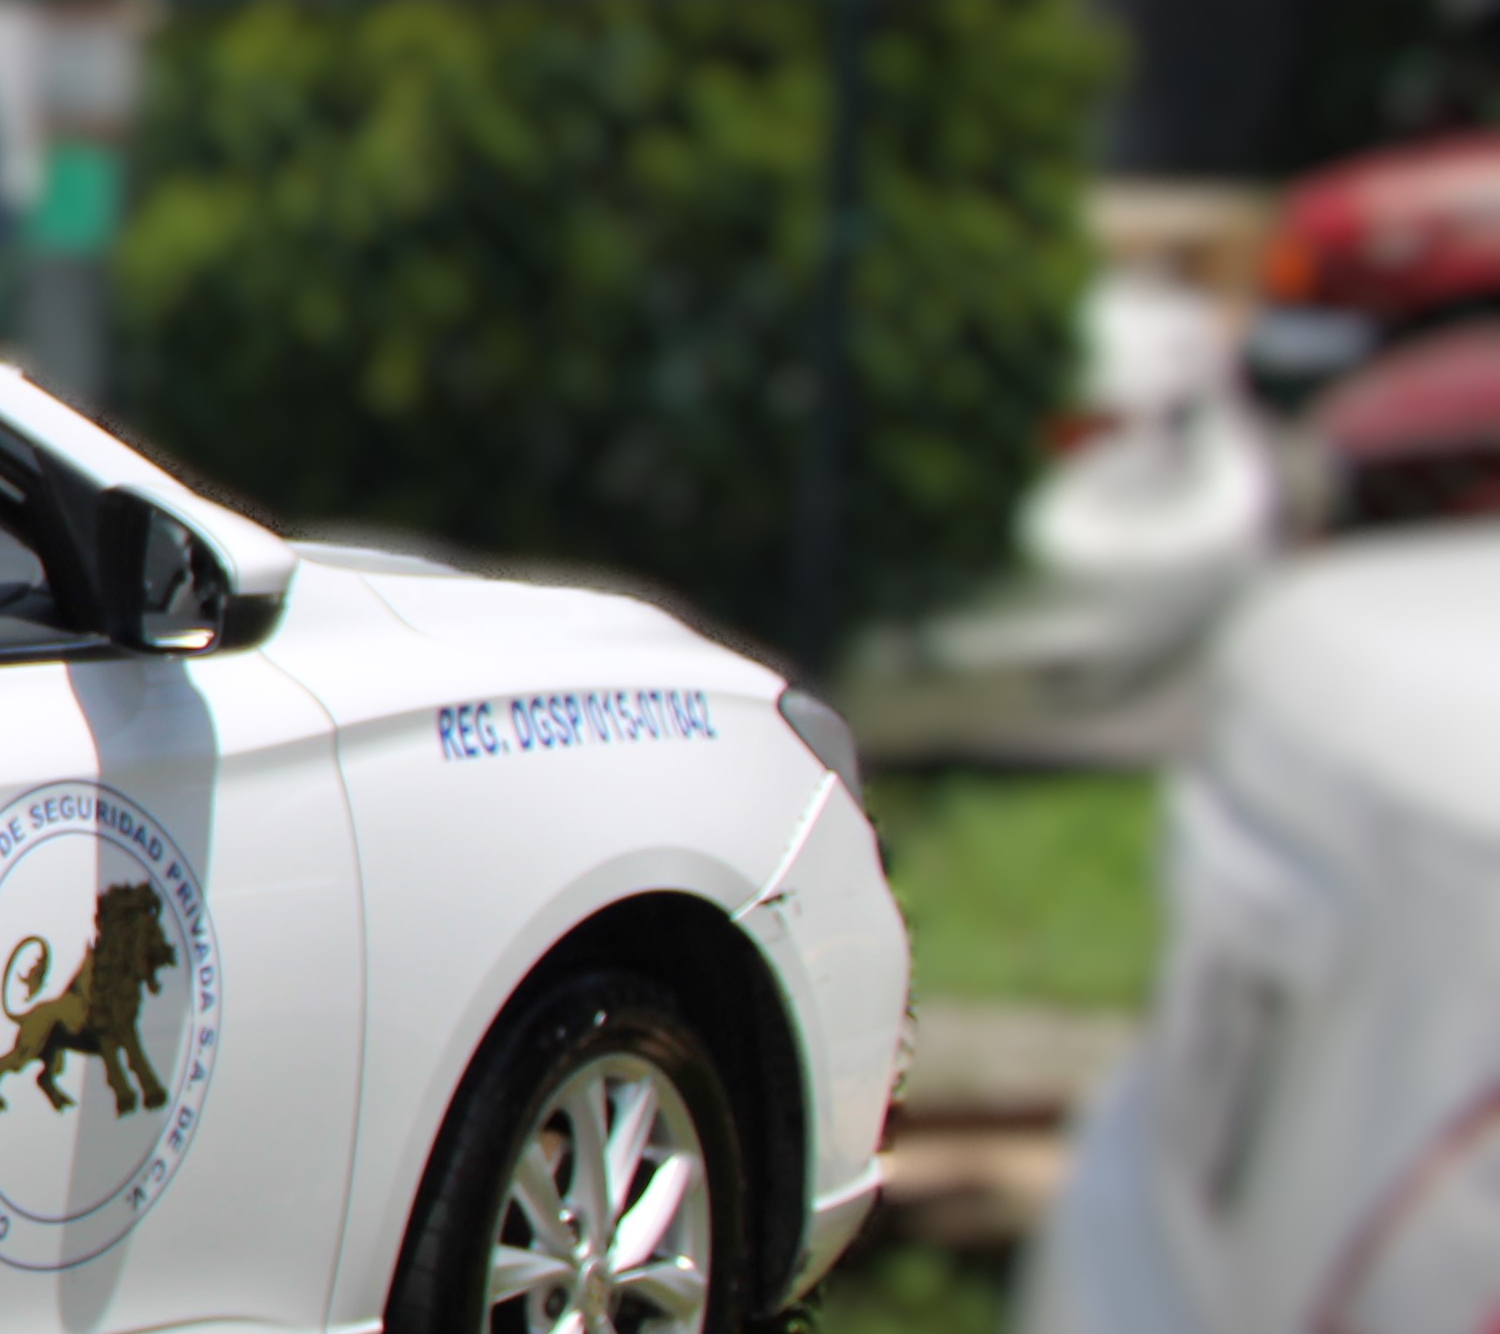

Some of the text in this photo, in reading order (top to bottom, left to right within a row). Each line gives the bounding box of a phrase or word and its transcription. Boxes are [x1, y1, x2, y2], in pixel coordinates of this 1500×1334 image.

[438, 700, 509, 761] REG.
[29, 795, 164, 861] SEGURIDAD
[165, 864, 215, 1014] PRIVADA
[168, 1105, 193, 1152] DE
